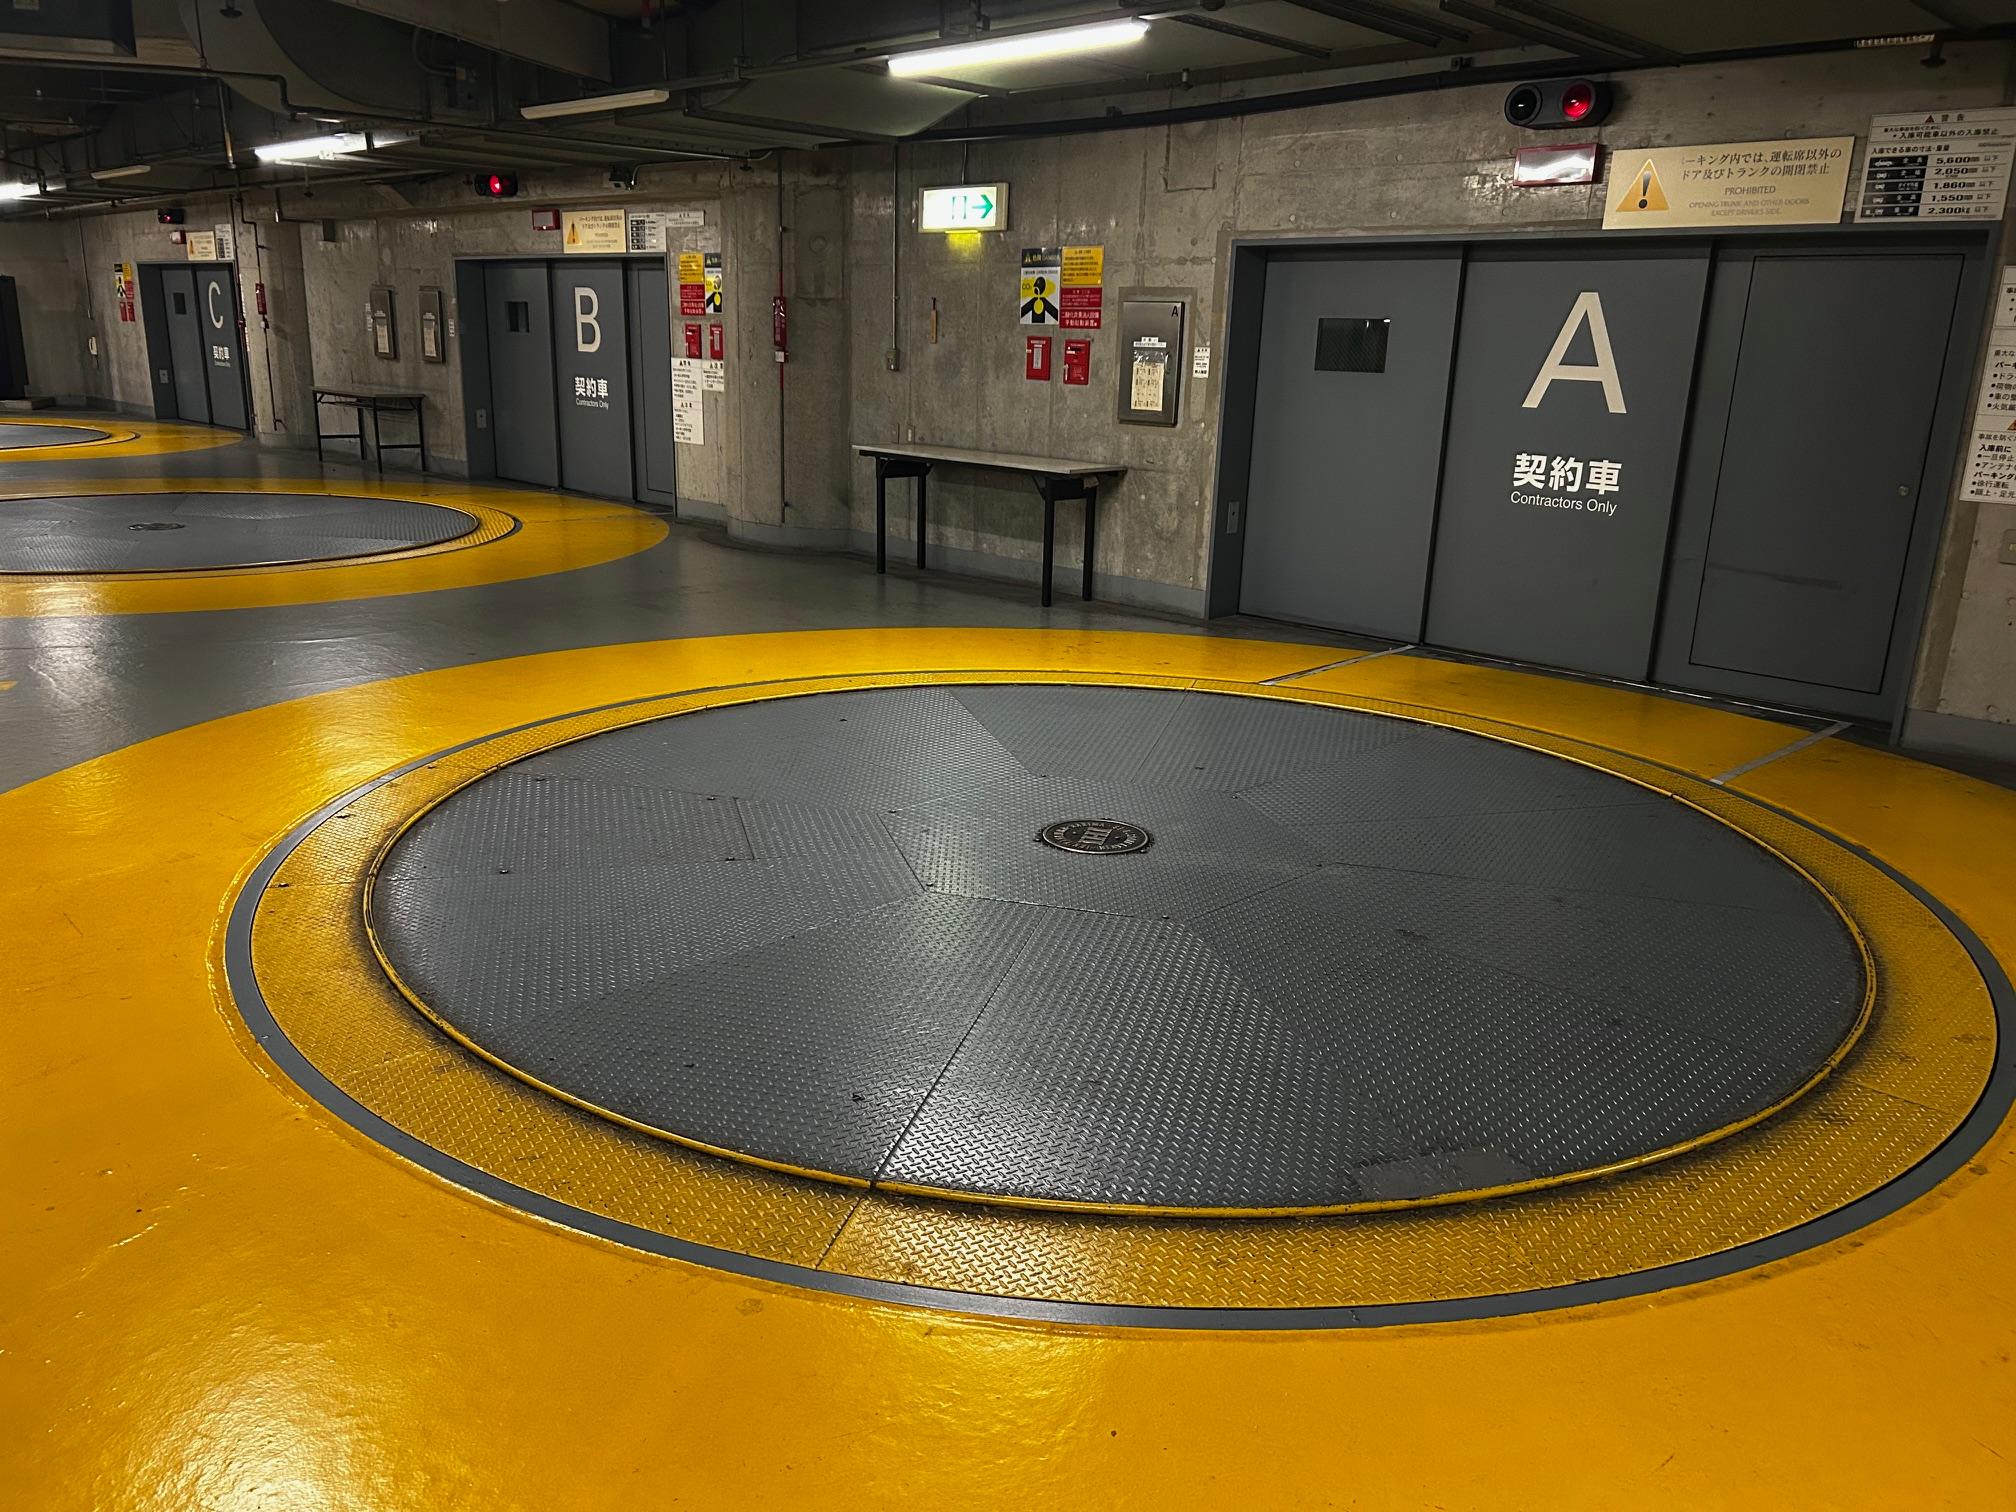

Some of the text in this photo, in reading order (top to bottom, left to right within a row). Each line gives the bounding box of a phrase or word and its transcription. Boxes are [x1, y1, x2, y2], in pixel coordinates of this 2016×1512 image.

[1681, 148, 1842, 166] ーキング内では、運転席以外の
[1724, 185, 1776, 195] PROHIBITED
[208, 281, 224, 329] C
[1171, 306, 1179, 317] A
[574, 286, 602, 353] B
[1521, 291, 1627, 414] A
[1999, 372, 2016, 380] ドラ
[575, 376, 609, 399] 契約車
[1513, 452, 1622, 495] 契約車
[1973, 470, 2016, 480] パーキング
[1981, 462, 2016, 471] アンテナ
[1510, 491, 1617, 517] Contractors Only
